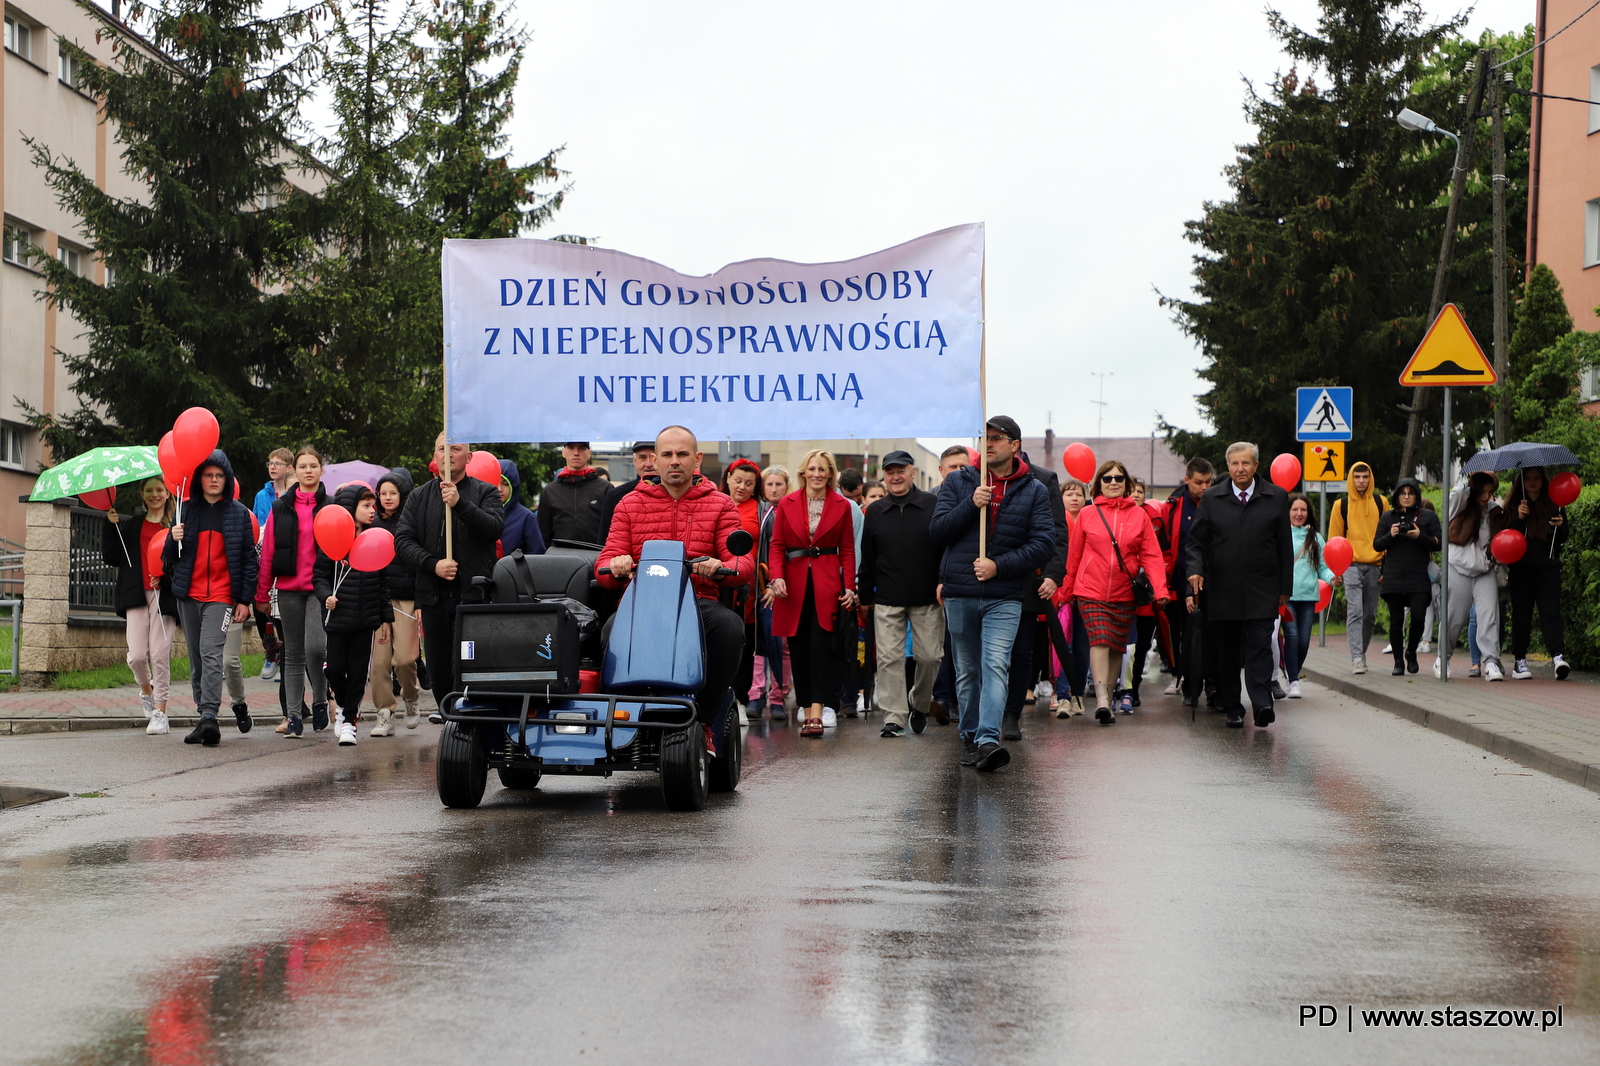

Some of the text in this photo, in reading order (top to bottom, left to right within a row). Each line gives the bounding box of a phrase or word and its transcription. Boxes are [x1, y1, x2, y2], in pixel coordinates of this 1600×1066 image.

[500, 269, 934, 306] DZIEŃ GODNOŚCI OSOBY
[484, 313, 948, 356] Z NIEPEŁNOSPRAWNOŚCIĄ
[578, 372, 864, 408] INTELEKTUALNĄ
